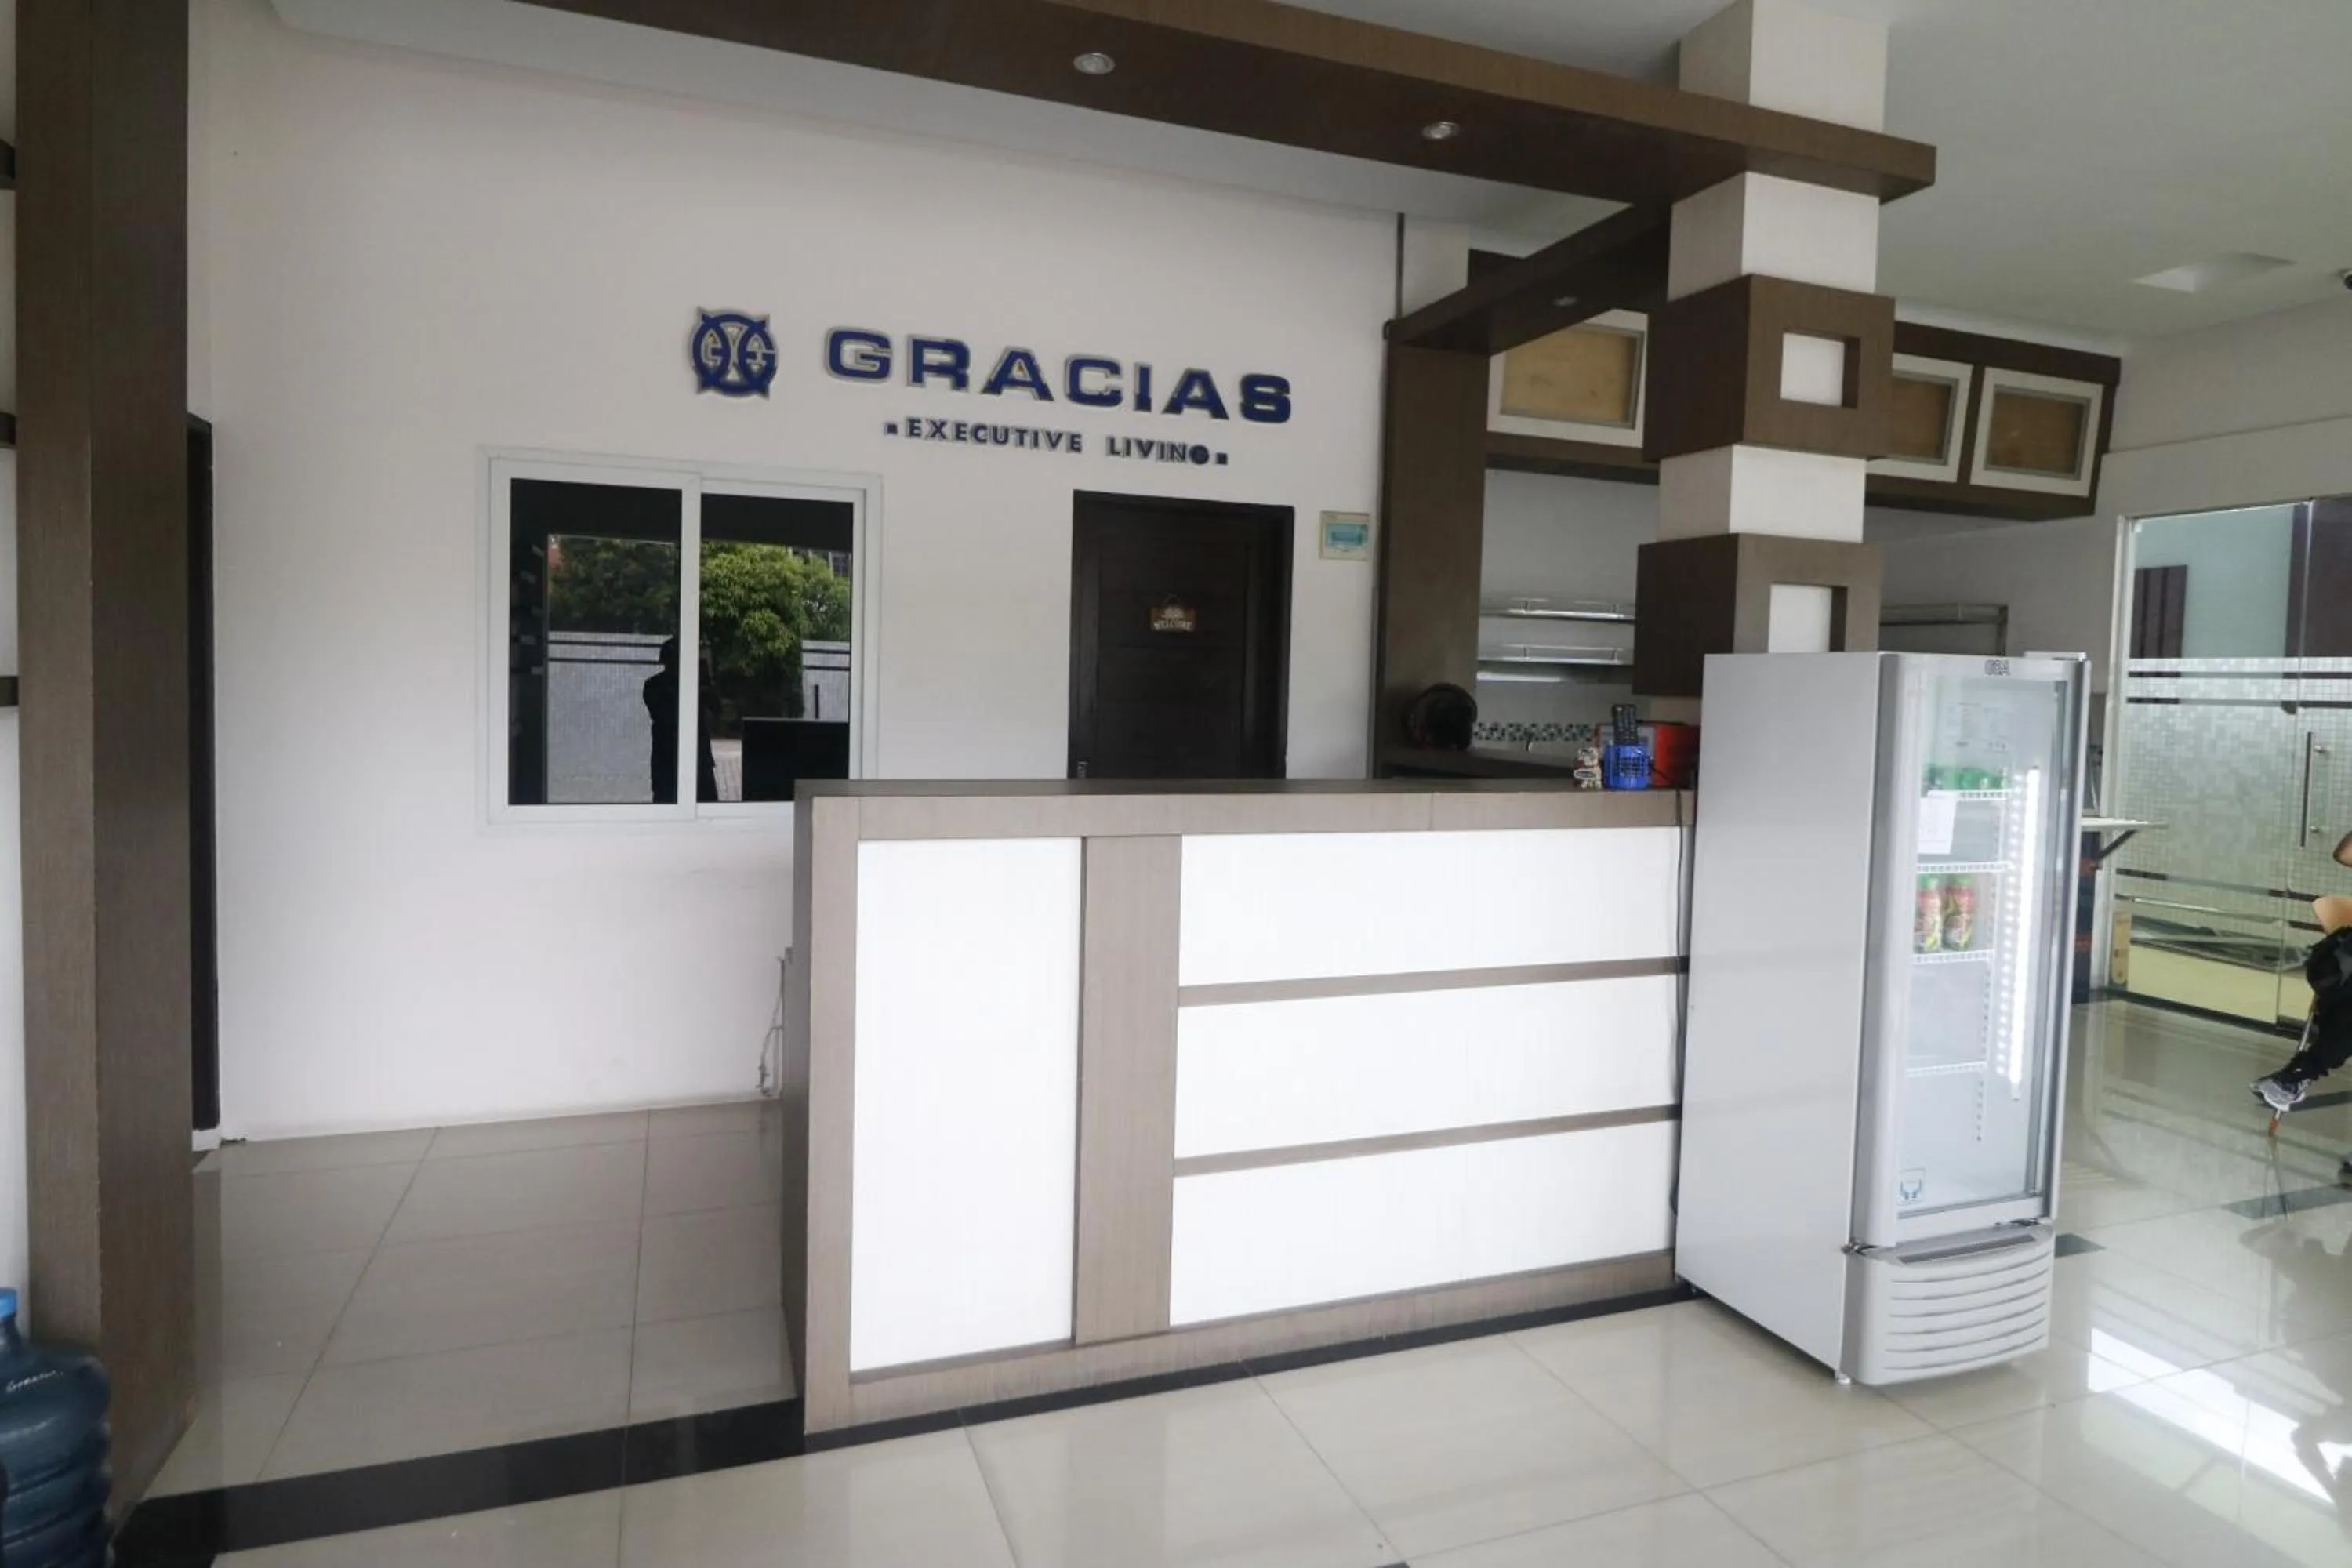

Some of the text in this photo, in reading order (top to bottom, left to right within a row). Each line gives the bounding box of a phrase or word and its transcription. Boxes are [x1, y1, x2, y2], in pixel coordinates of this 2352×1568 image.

[824, 326, 1292, 425] GRACIAS
[906, 416, 1210, 465] EXECUTIVE LIVIN
